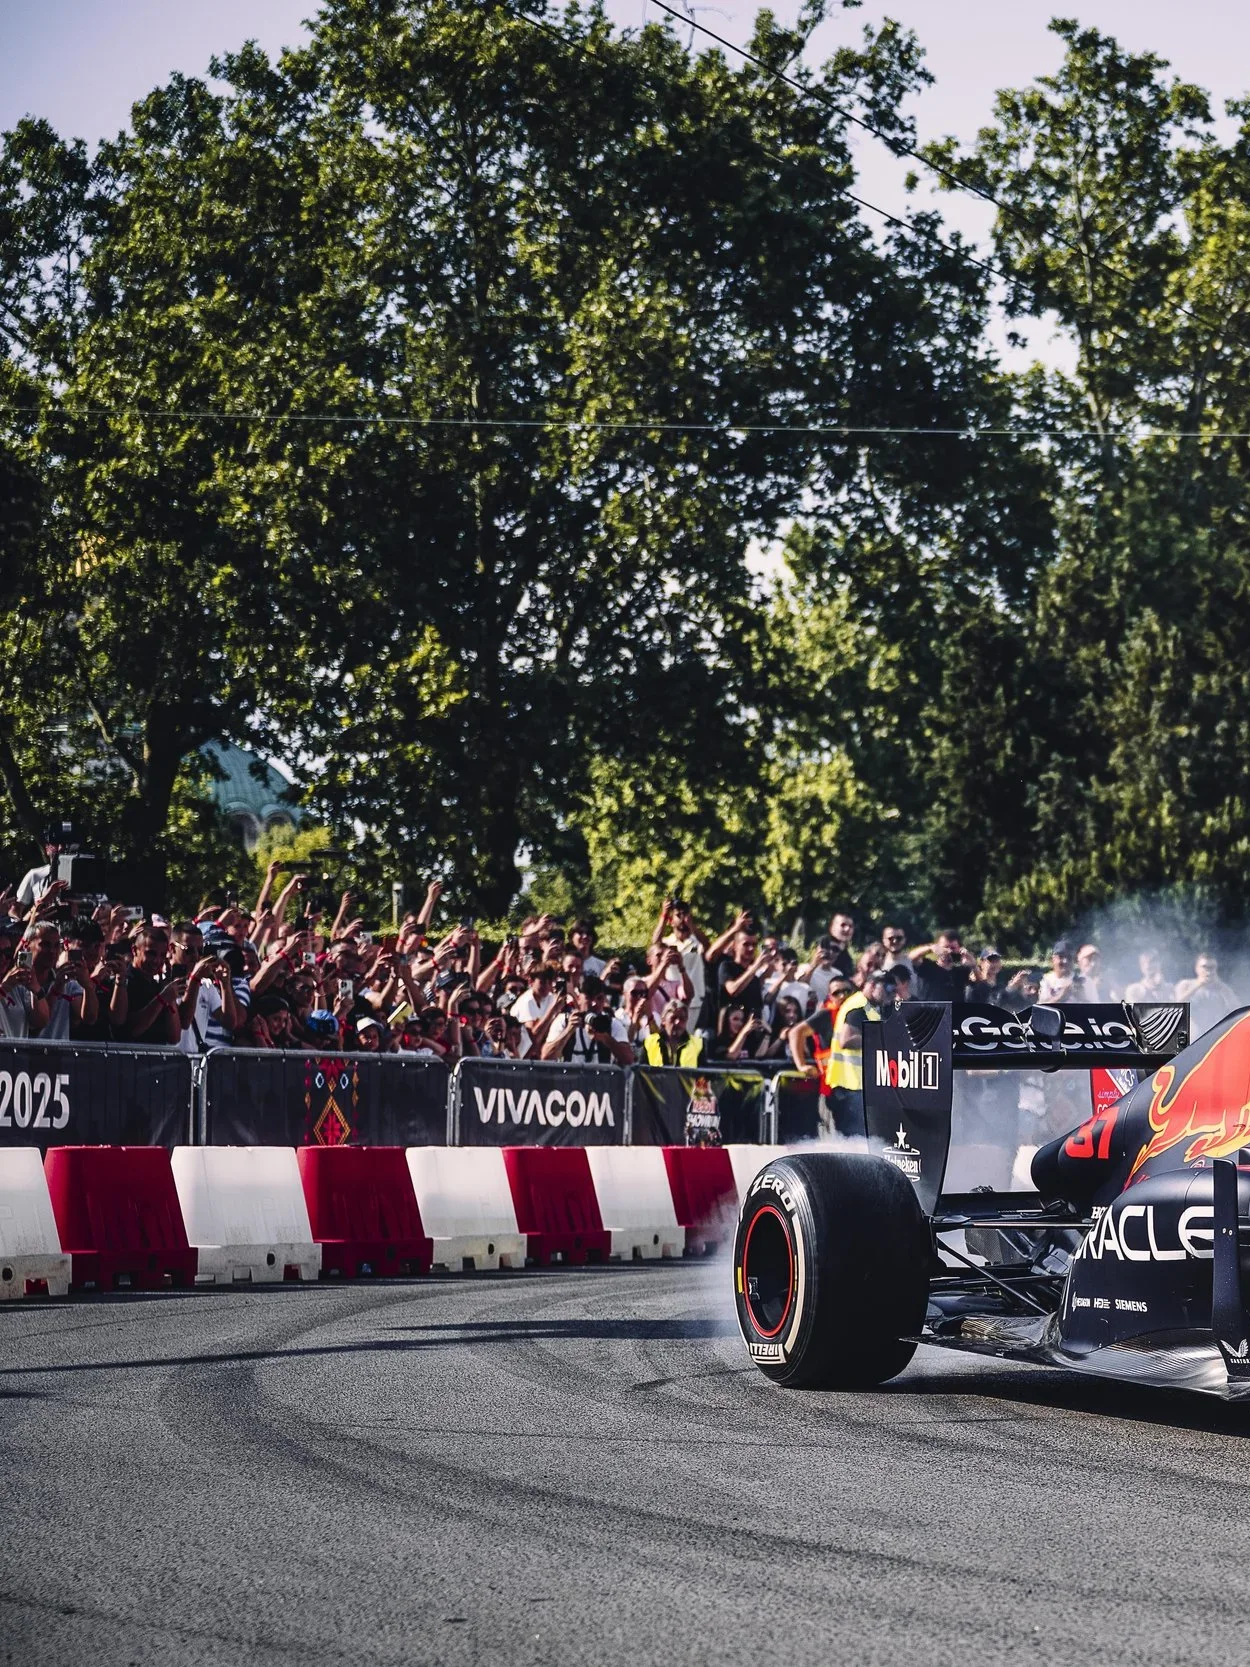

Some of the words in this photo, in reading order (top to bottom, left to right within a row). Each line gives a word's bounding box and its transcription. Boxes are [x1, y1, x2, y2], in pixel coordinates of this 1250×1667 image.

[962, 1017, 1134, 1050] Gae.io
[876, 1050, 918, 1088] Mobil
[0, 1070, 70, 1129] 2025
[474, 1086, 615, 1128] VIVACOM
[751, 1173, 797, 1213] ZERO
[1075, 1204, 1215, 1261] RACLE
[1114, 1298, 1148, 1313] SIEMENS
[749, 1342, 787, 1364] PIRELLI
